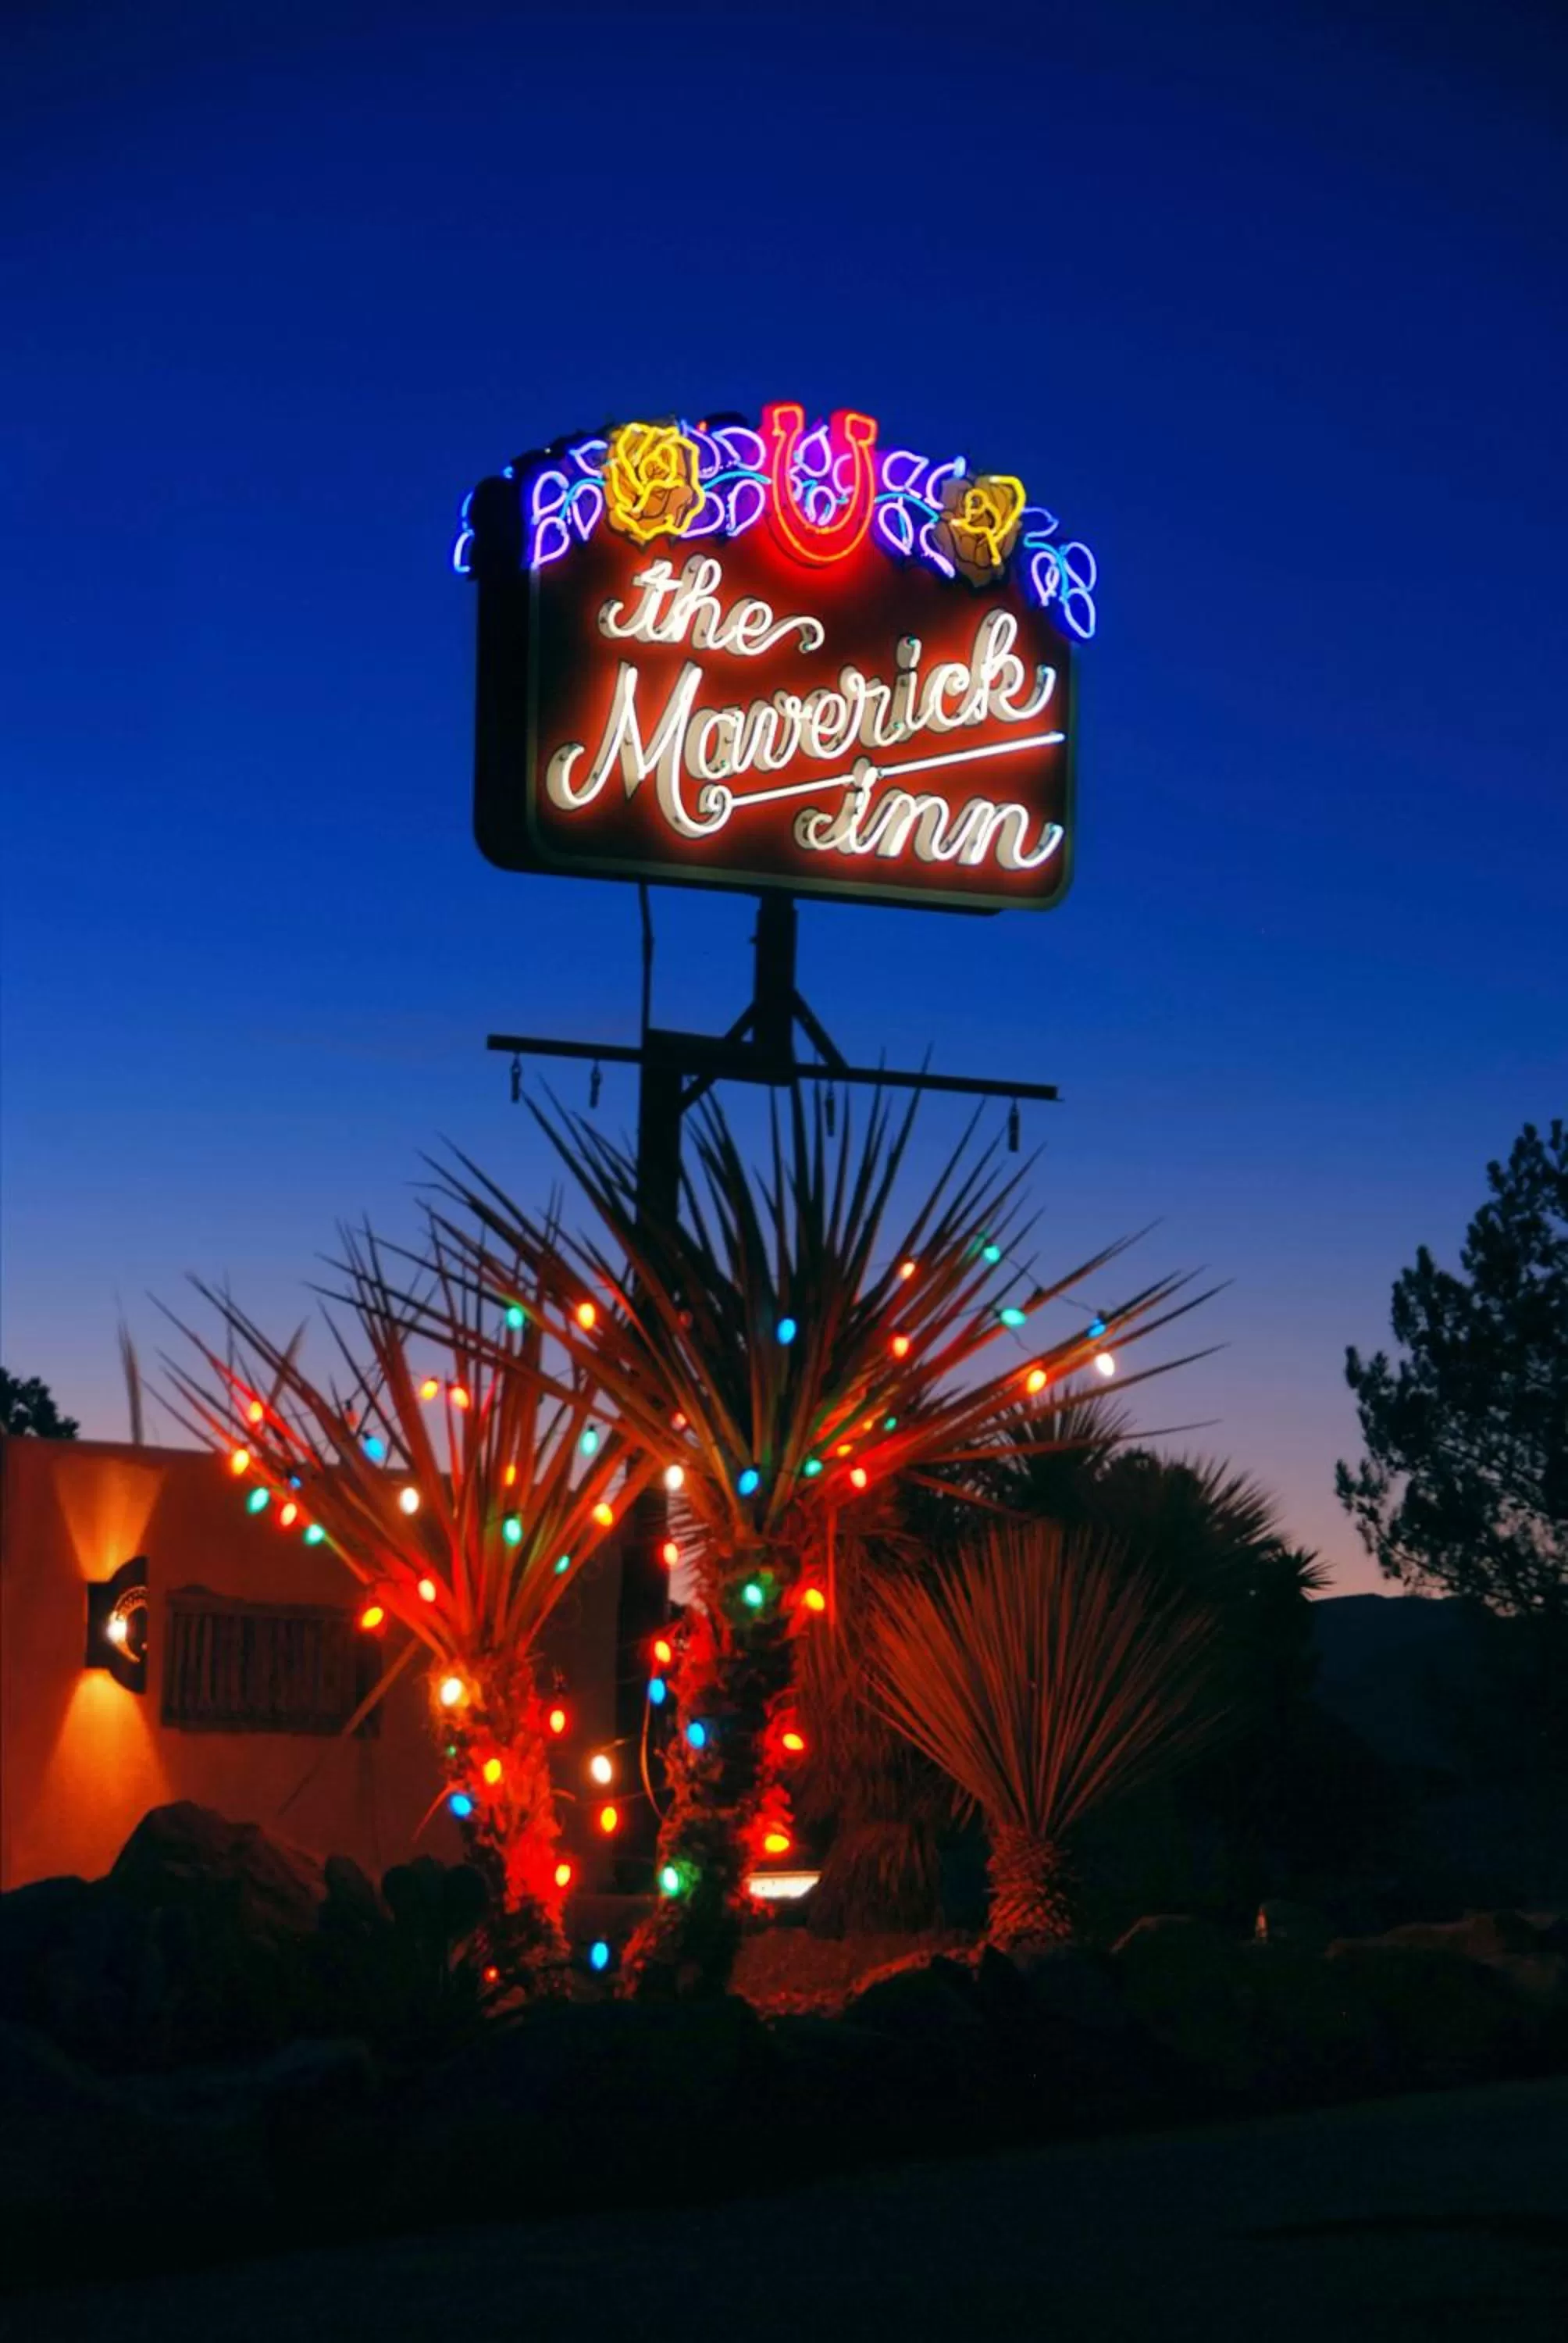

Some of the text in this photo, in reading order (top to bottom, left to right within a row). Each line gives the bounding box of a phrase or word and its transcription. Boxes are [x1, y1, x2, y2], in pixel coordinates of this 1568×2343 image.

[599, 554, 824, 655] the
[547, 608, 1054, 838] Maverick
[793, 757, 1064, 869] inn
